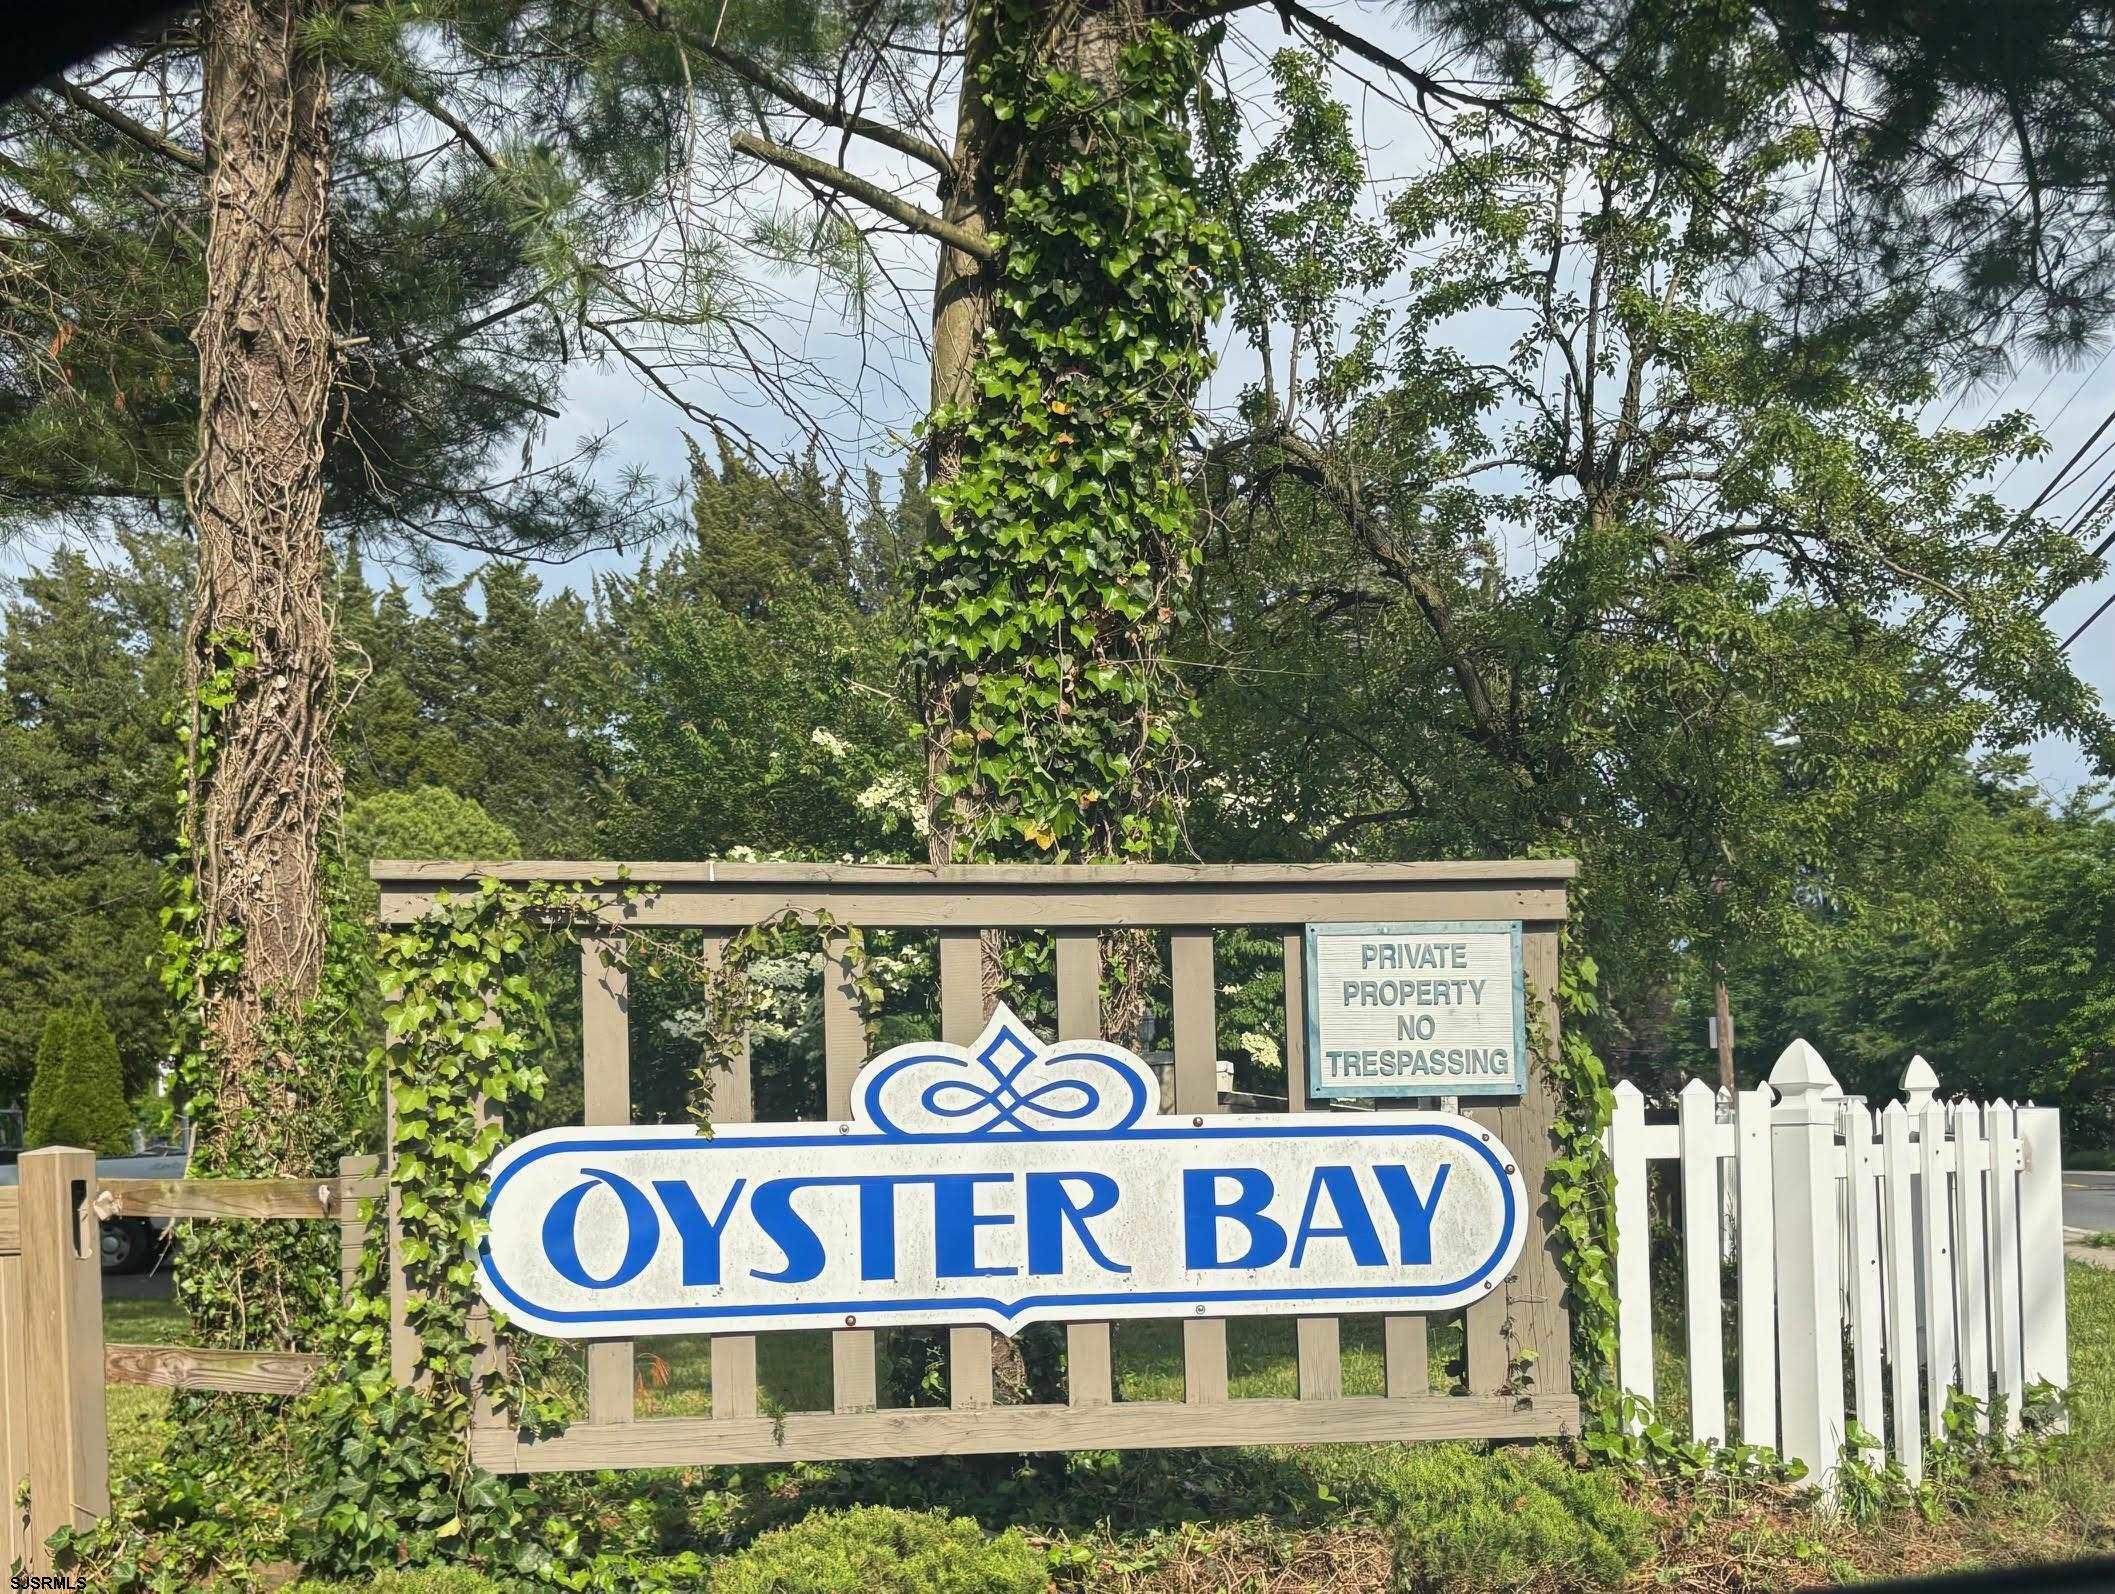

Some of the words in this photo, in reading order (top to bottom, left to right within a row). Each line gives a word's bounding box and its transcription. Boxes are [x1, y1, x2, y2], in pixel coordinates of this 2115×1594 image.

[1361, 943, 1468, 969] PRIVATE
[1343, 979, 1486, 1006] PROPERTY
[1397, 1014, 1436, 1041] NO
[1325, 1049, 1509, 1077] TRESPASSING
[541, 1167, 1132, 1290] OYSTER
[1182, 1163, 1452, 1271] BAY
